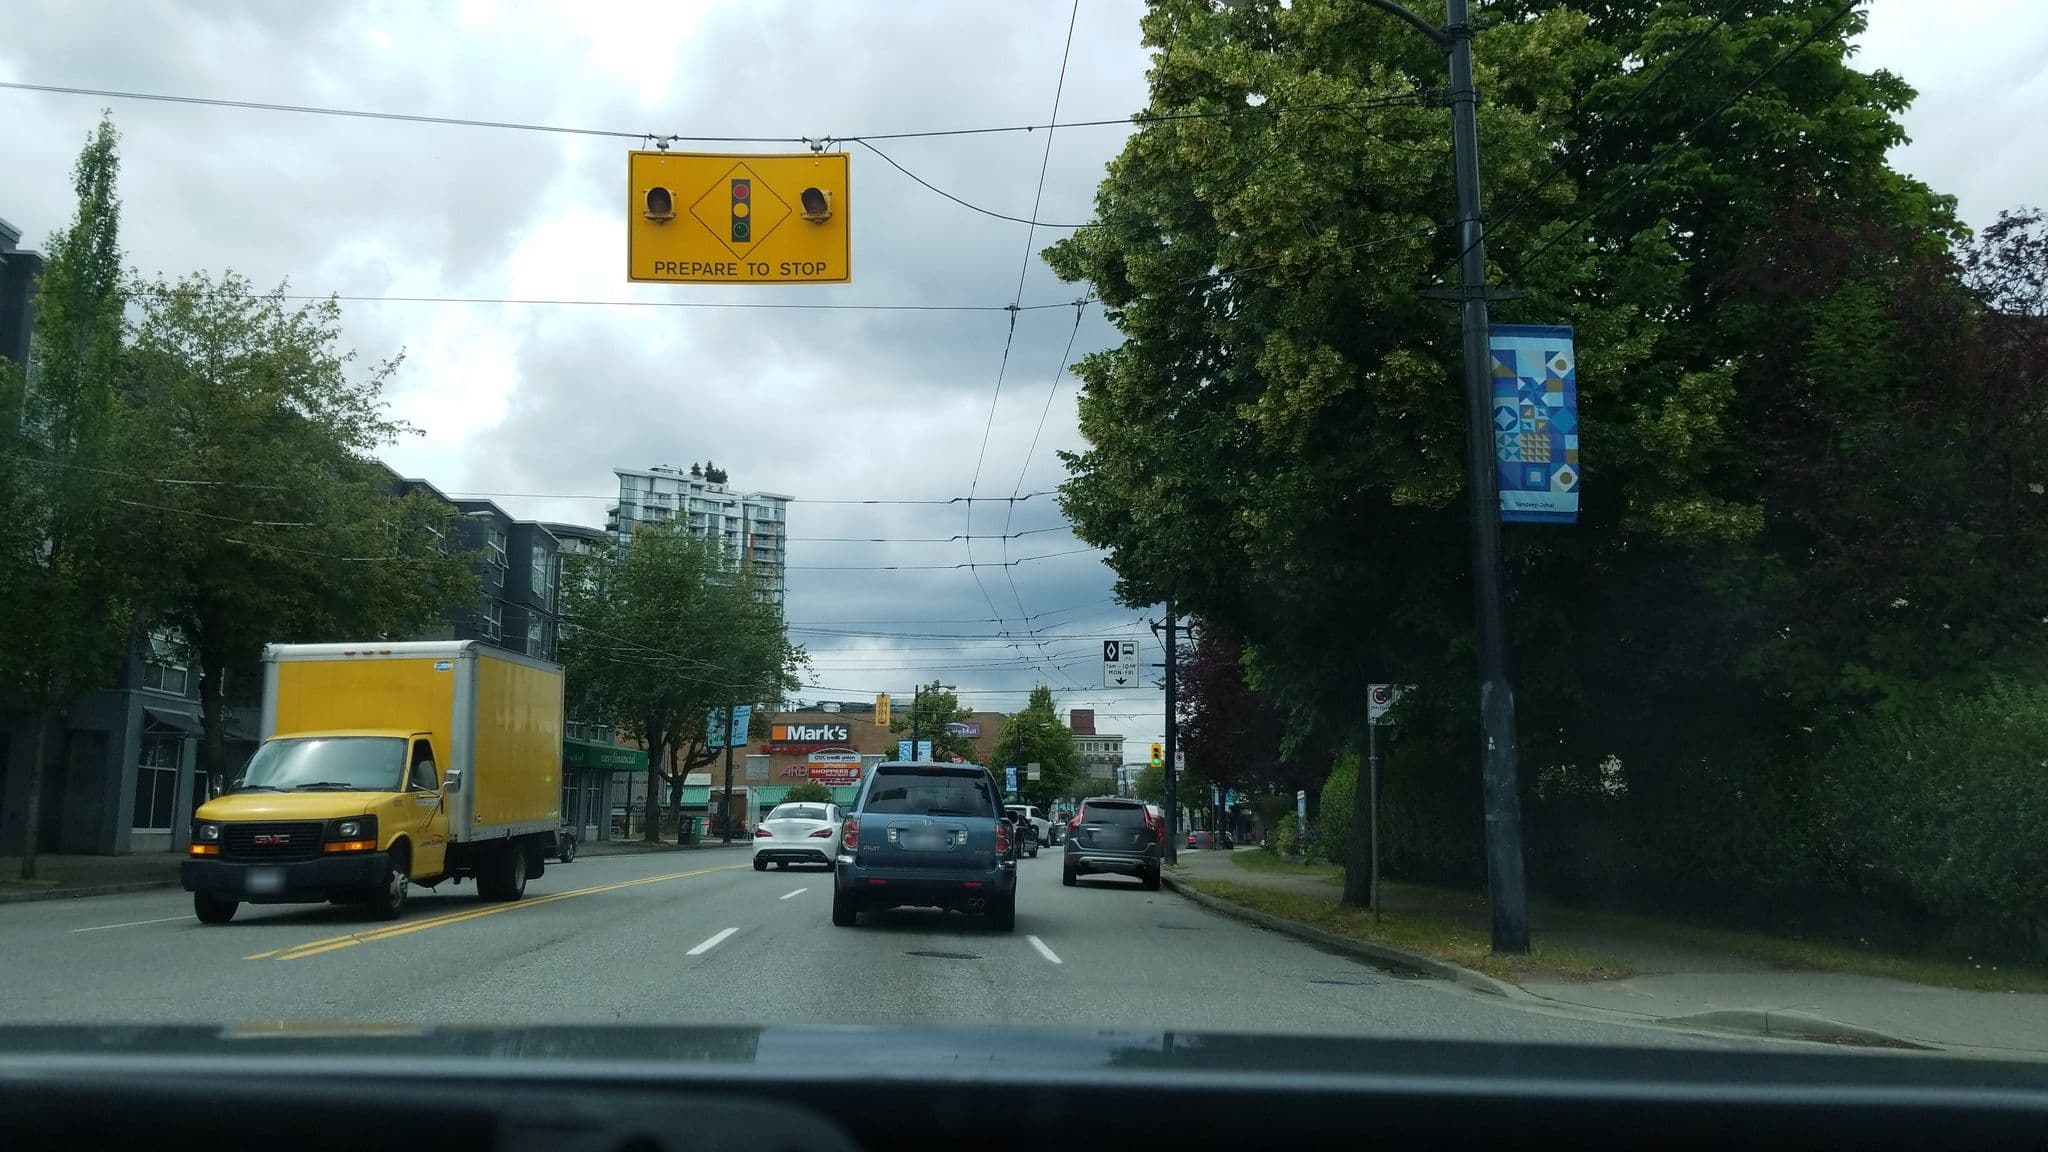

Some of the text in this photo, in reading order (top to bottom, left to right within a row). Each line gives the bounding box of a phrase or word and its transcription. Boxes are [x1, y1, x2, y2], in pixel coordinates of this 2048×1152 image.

[654, 261, 827, 276] PREPARE TO STOP
[787, 724, 848, 740] Mark's
[778, 764, 808, 777] ARD
[254, 834, 290, 844] GMC
